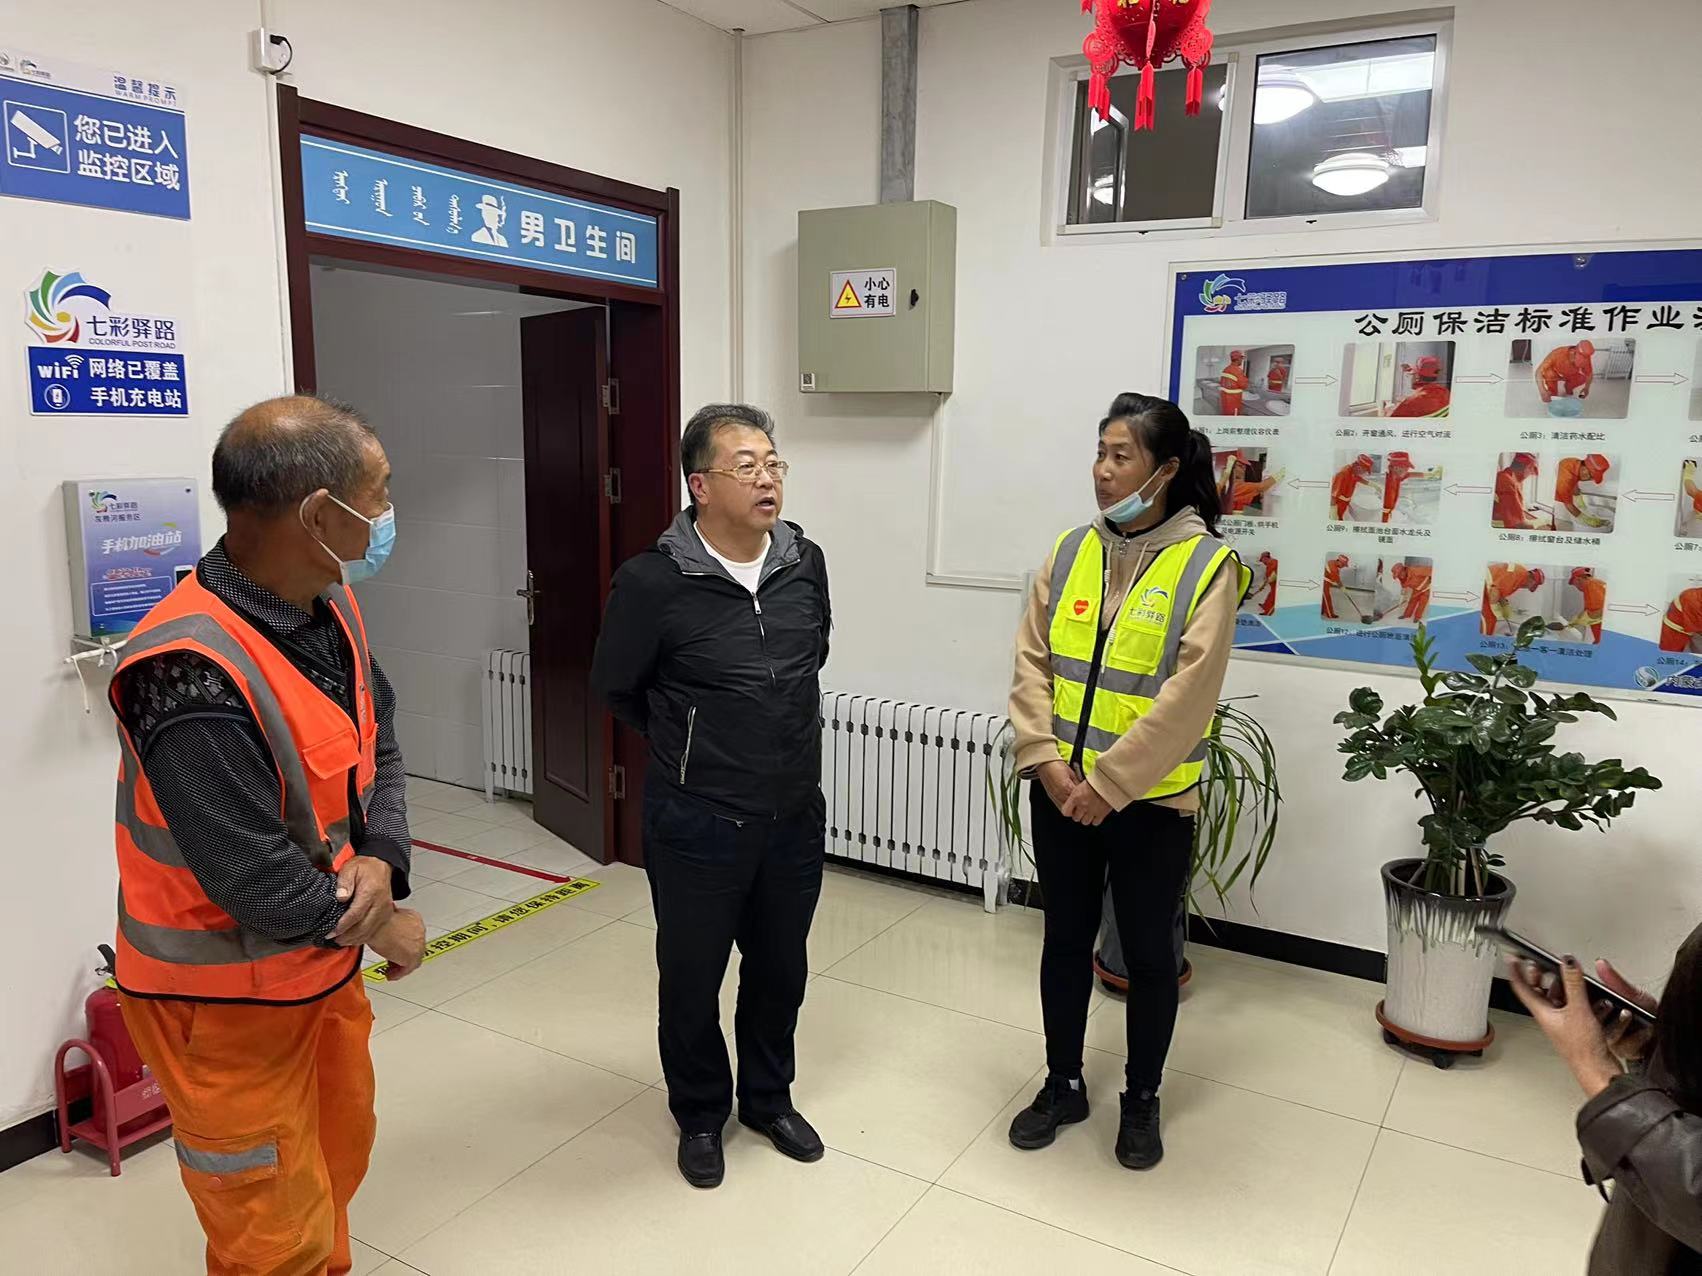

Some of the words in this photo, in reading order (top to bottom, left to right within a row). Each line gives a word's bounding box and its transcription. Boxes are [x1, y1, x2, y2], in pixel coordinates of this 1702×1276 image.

[114, 75, 176, 100] 温馨提示
[73, 114, 179, 159] 您已进入
[77, 149, 180, 191] 监控区域
[521, 211, 636, 264] 男卫生间
[864, 277, 890, 291] 小心
[864, 294, 890, 308] 有电
[87, 316, 175, 341] 七彩驿路
[1354, 305, 1702, 336] 公厕保洁标准作业
[89, 338, 130, 347] COLORFUL
[132, 340, 152, 348] POST
[154, 340, 176, 349] ROAD
[89, 358, 180, 380] 网络已覆盖
[90, 387, 182, 408] 手机充电站
[101, 530, 182, 554] 手机加油站
